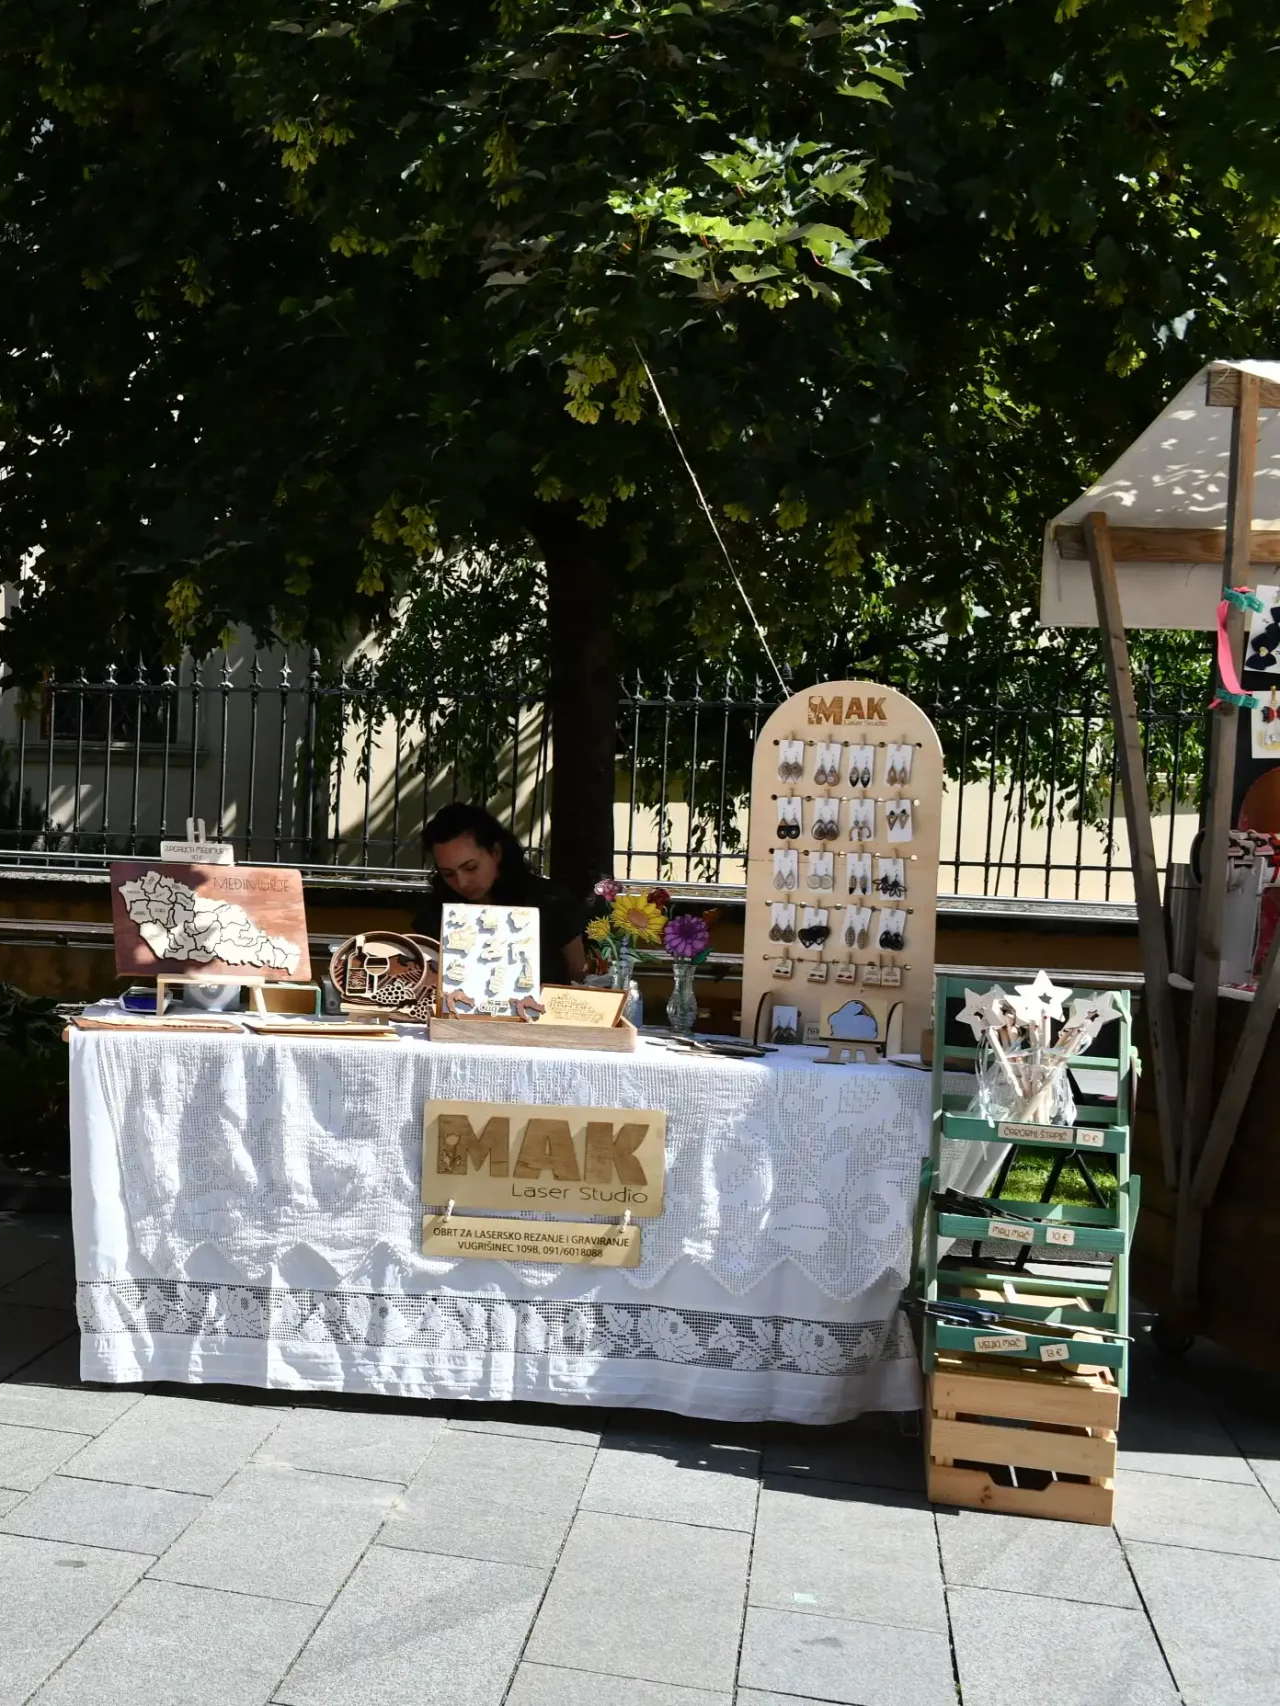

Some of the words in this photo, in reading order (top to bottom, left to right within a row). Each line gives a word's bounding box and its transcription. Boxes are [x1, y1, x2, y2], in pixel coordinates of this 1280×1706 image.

[808, 696, 887, 725] MAK
[436, 1114, 650, 1186] MAK
[512, 1184, 569, 1200] Laser
[580, 1186, 648, 1204] Studio
[433, 1227, 458, 1237] OBRT
[460, 1228, 472, 1238] ZA
[474, 1230, 522, 1240] LASERSKO
[524, 1232, 564, 1244] REZANJE
[571, 1236, 630, 1247] GRAVIRANJE
[1051, 1230, 1061, 1240] 10
[458, 1240, 514, 1252] VUGRIŠINEC
[542, 1246, 603, 1258] 091/6018088
